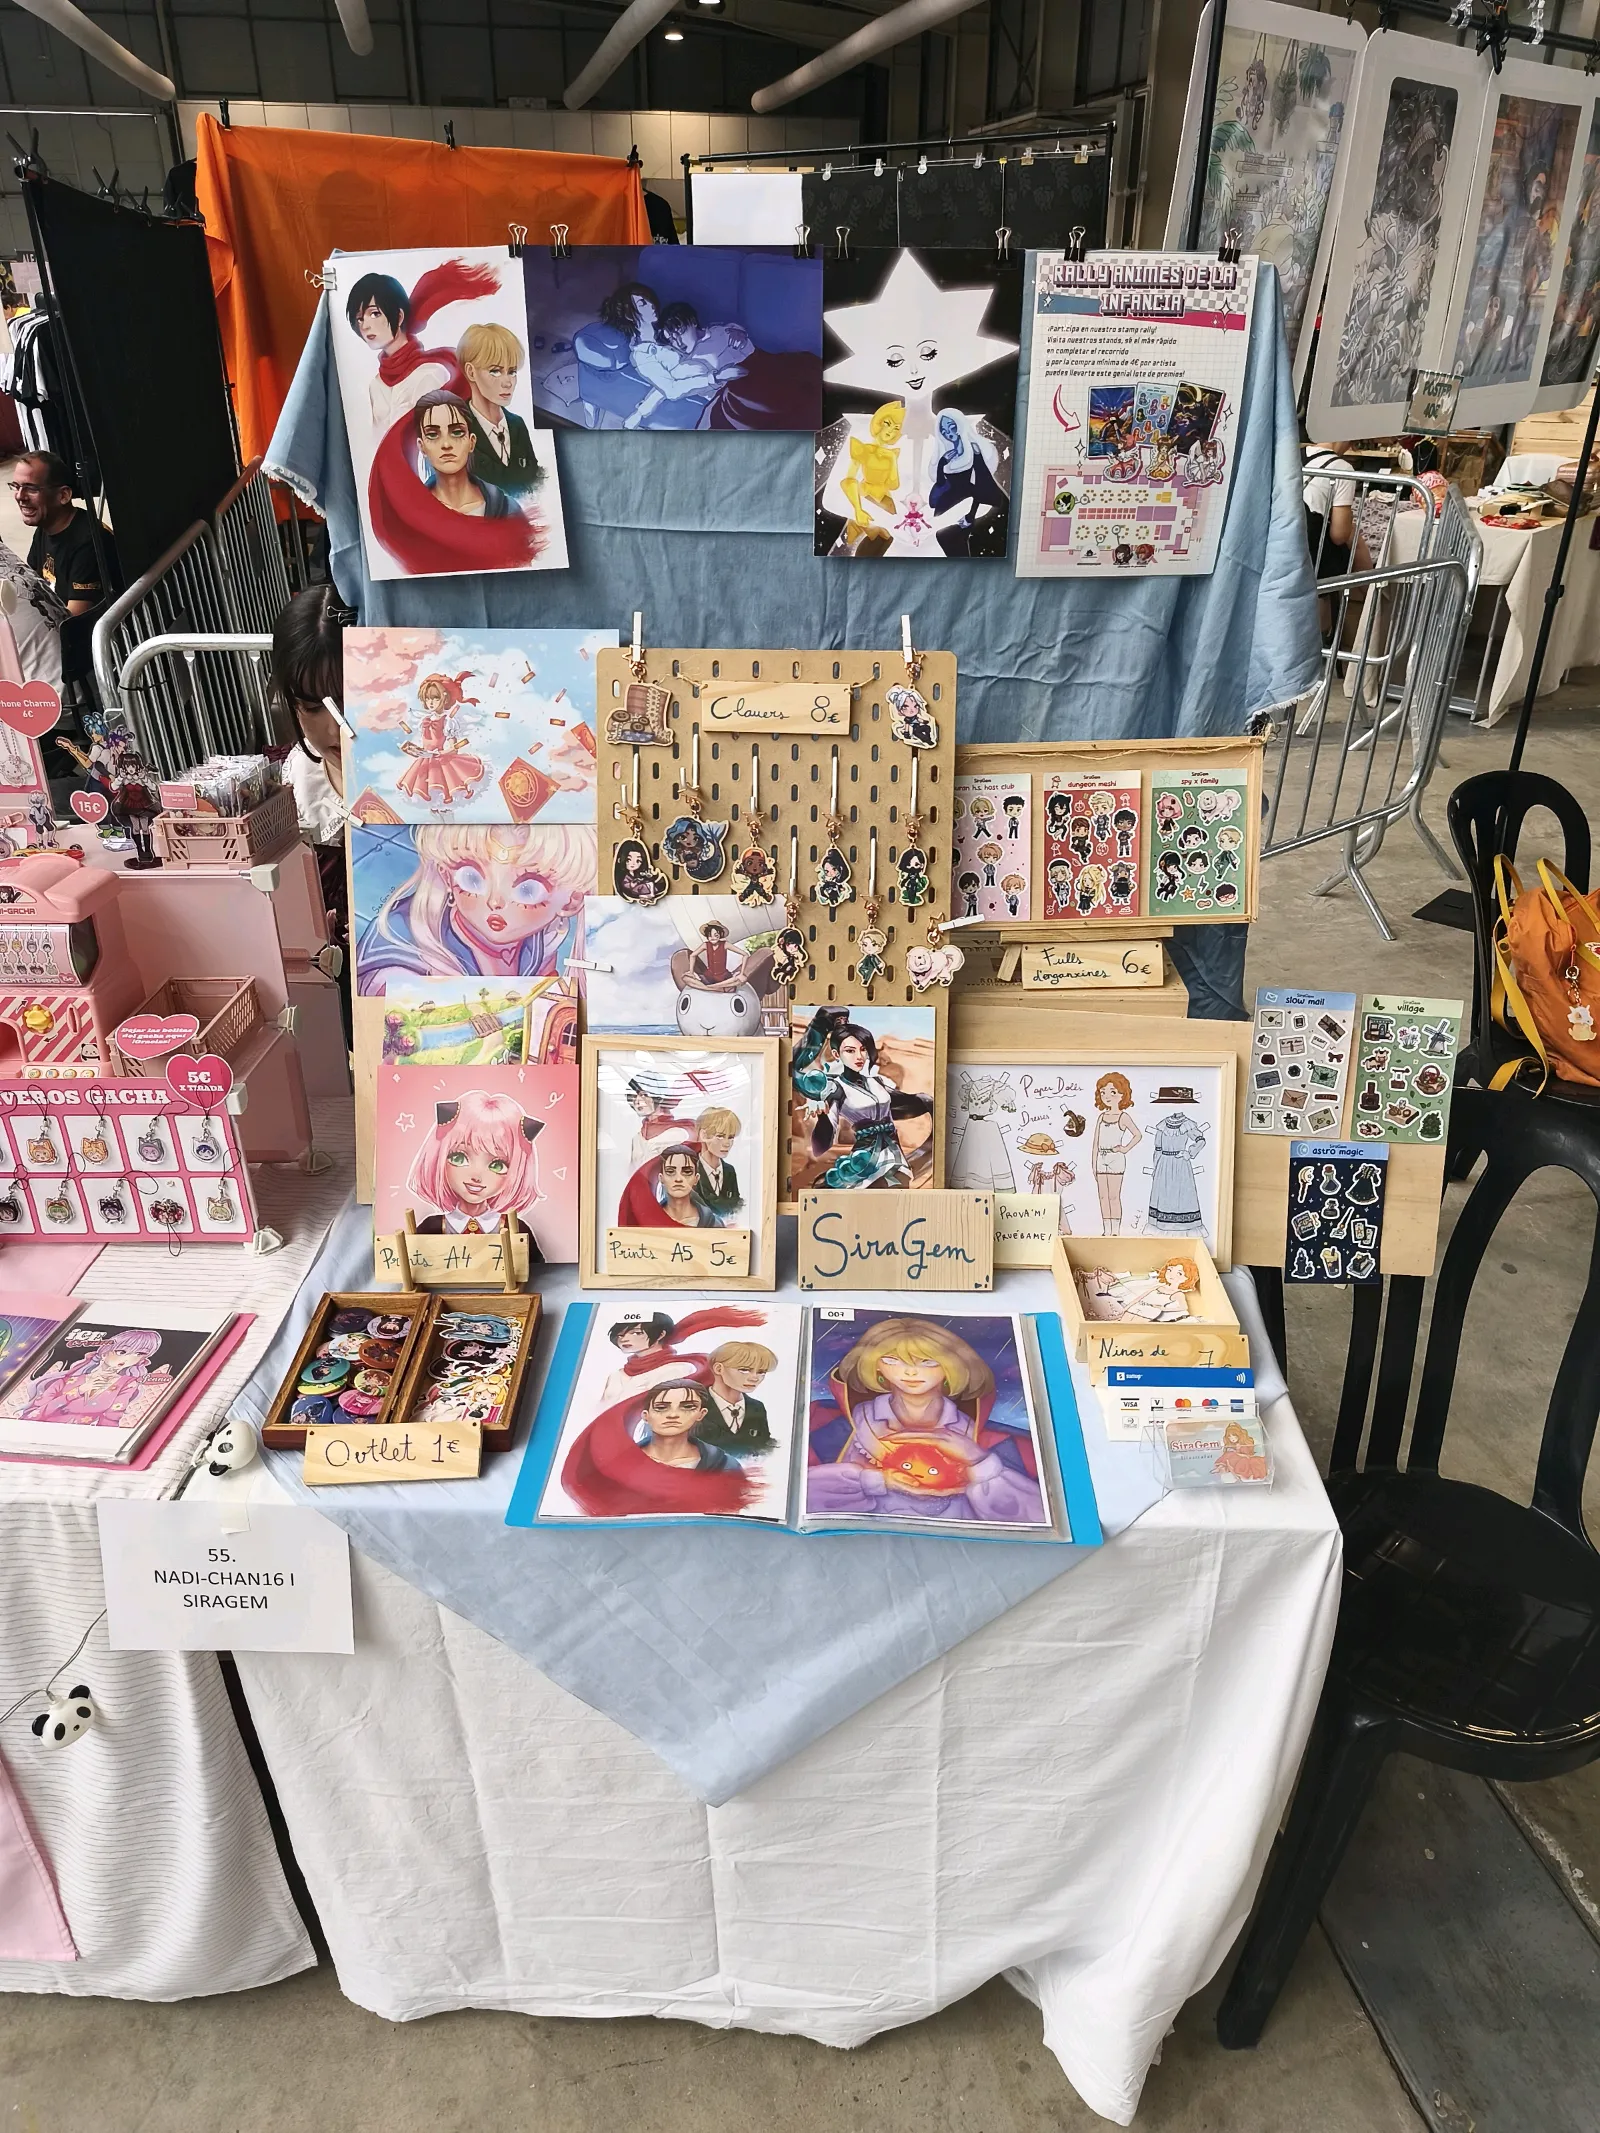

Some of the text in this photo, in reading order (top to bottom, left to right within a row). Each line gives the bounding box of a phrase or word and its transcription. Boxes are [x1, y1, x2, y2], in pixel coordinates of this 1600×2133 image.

[1053, 265, 1236, 289] RALLY ANIMES DE LA
[1100, 293, 1185, 316] INFANCIA
[1118, 326, 1138, 334] stamp
[1047, 336, 1066, 344] Visita
[1055, 347, 1089, 356] completar
[1097, 347, 1129, 355] recorrido
[1051, 359, 1062, 367] por
[1070, 359, 1095, 367] compra
[1152, 359, 1177, 367] artista
[1044, 369, 1069, 378] puedes
[1069, 369, 1095, 377] llevarte
[1112, 370, 1132, 378] genial
[0, 699, 56, 708] hone Charms
[810, 695, 841, 725] 8€
[23, 710, 34, 718] 6€
[1000, 783, 1015, 791] club
[1067, 780, 1117, 789] dungeon meshi
[1200, 777, 1219, 785] family
[78, 801, 101, 814] 15€
[1040, 946, 1084, 967] Fulls
[1121, 949, 1152, 975] 6€
[1286, 996, 1325, 1006] slow mail
[1397, 1004, 1425, 1015] village
[187, 1071, 211, 1084] 5€
[1019, 1074, 1084, 1098] Paper Dolls
[85, 1089, 172, 1106] GACHA
[1019, 1110, 1050, 1128] Dresses
[1312, 1147, 1364, 1157] astro magic
[608, 1239, 738, 1267] Prints A5 5€
[811, 1212, 976, 1280] SiraGem
[379, 1244, 506, 1271] Prnts A4 7
[1098, 1337, 1144, 1359] Ninos
[1150, 1344, 1170, 1357] de
[325, 1434, 460, 1467] Outlet 1€
[1171, 1440, 1220, 1451] SiraGem
[207, 1548, 236, 1563] 55.
[154, 1569, 285, 1586] NADI-CHAN16
[183, 1594, 268, 1610] SIRAGEM
